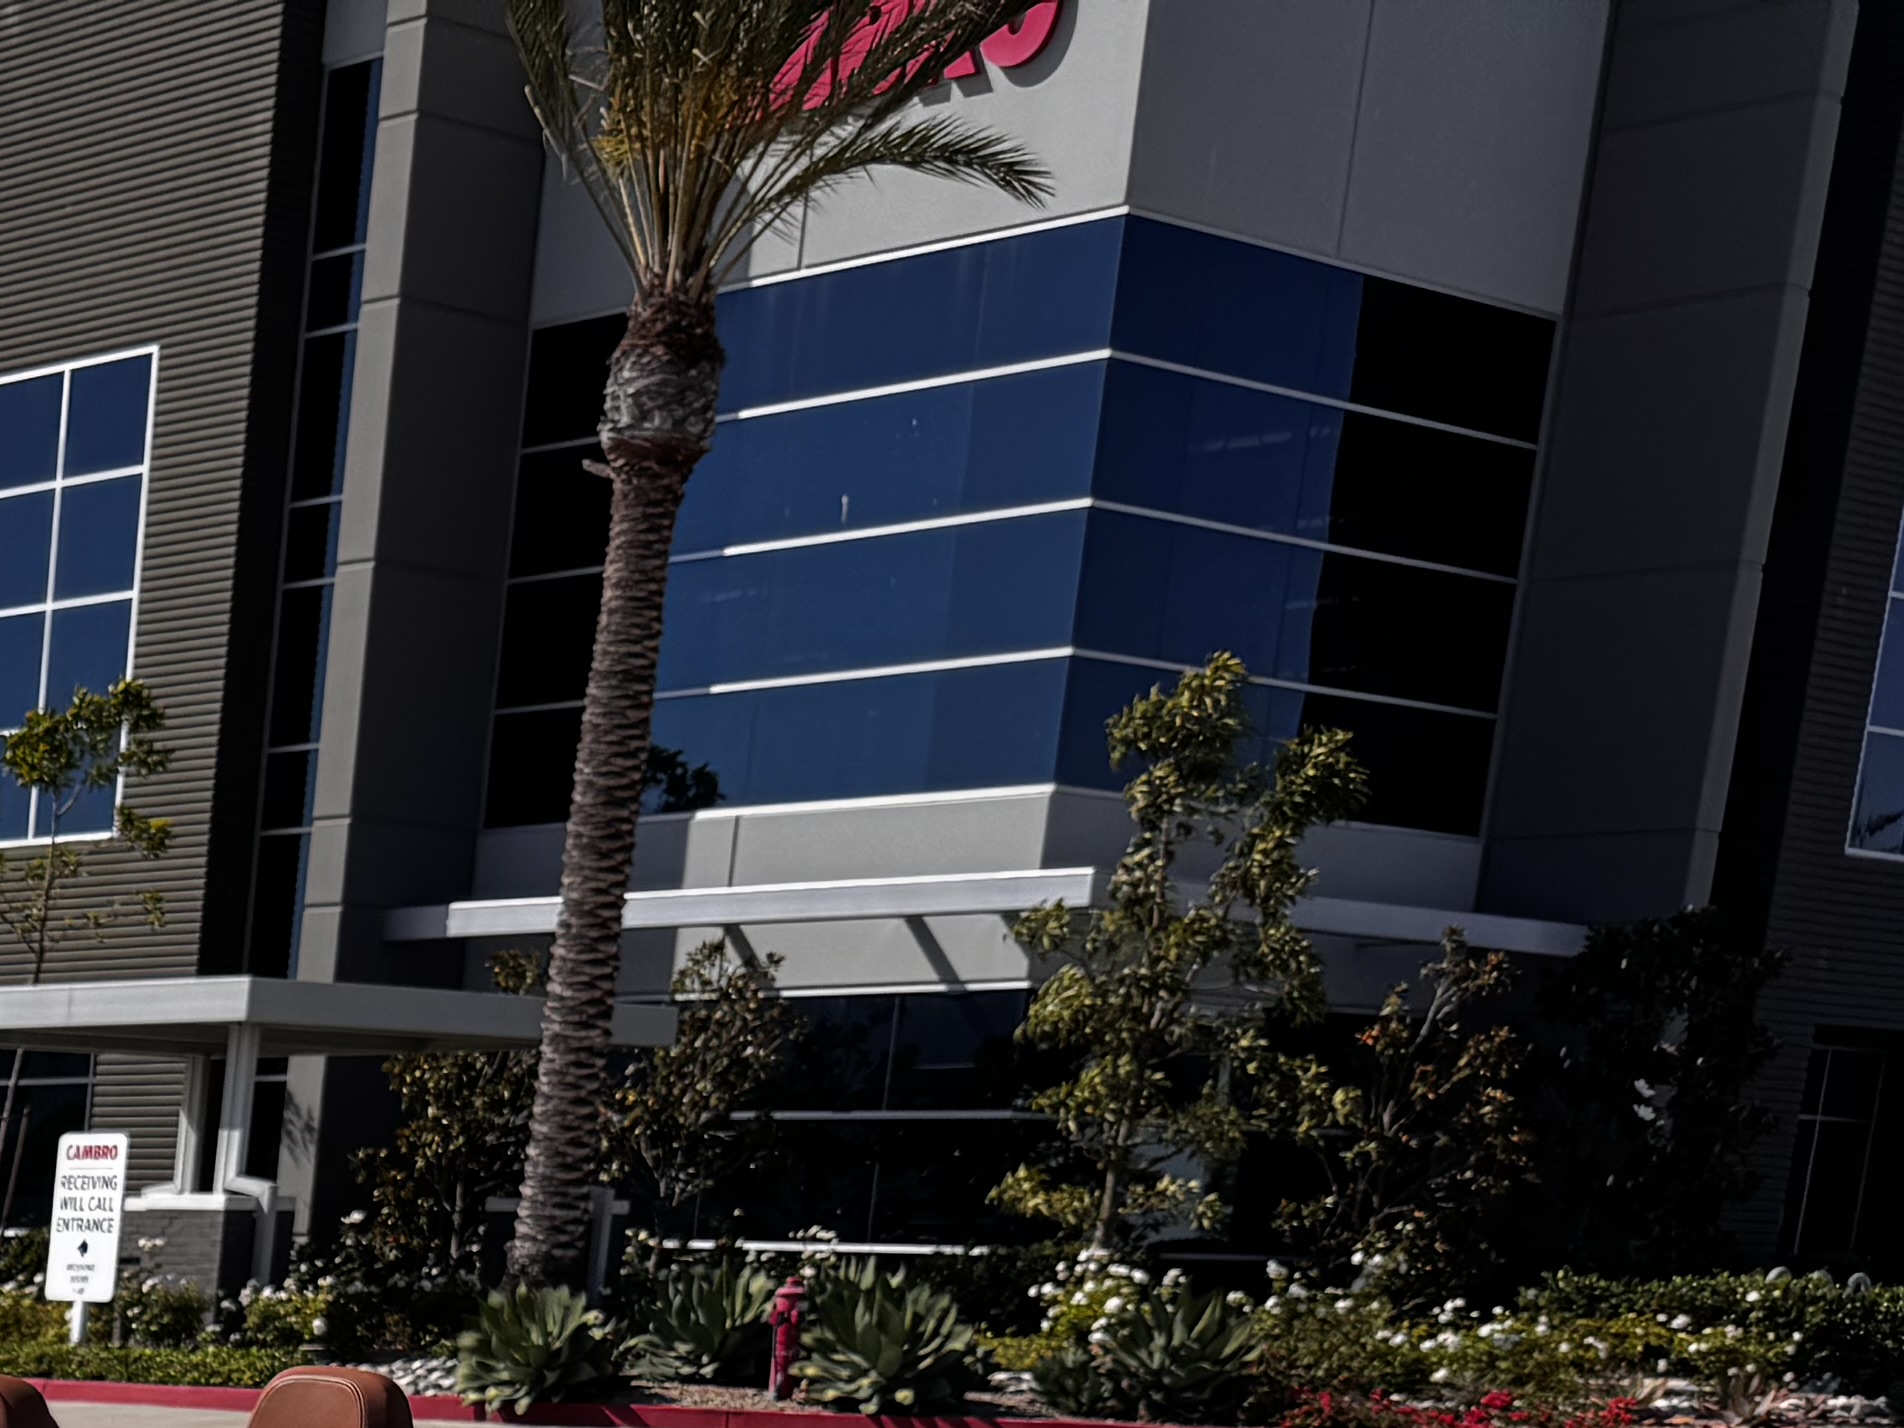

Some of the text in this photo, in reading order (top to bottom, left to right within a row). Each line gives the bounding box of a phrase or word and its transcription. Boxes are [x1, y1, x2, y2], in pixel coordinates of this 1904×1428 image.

[66, 1144, 119, 1160] CAMBRO
[60, 1175, 118, 1191] RECEIVING
[59, 1197, 114, 1212] WILL CALL
[56, 1218, 114, 1234] ENTRANCE
